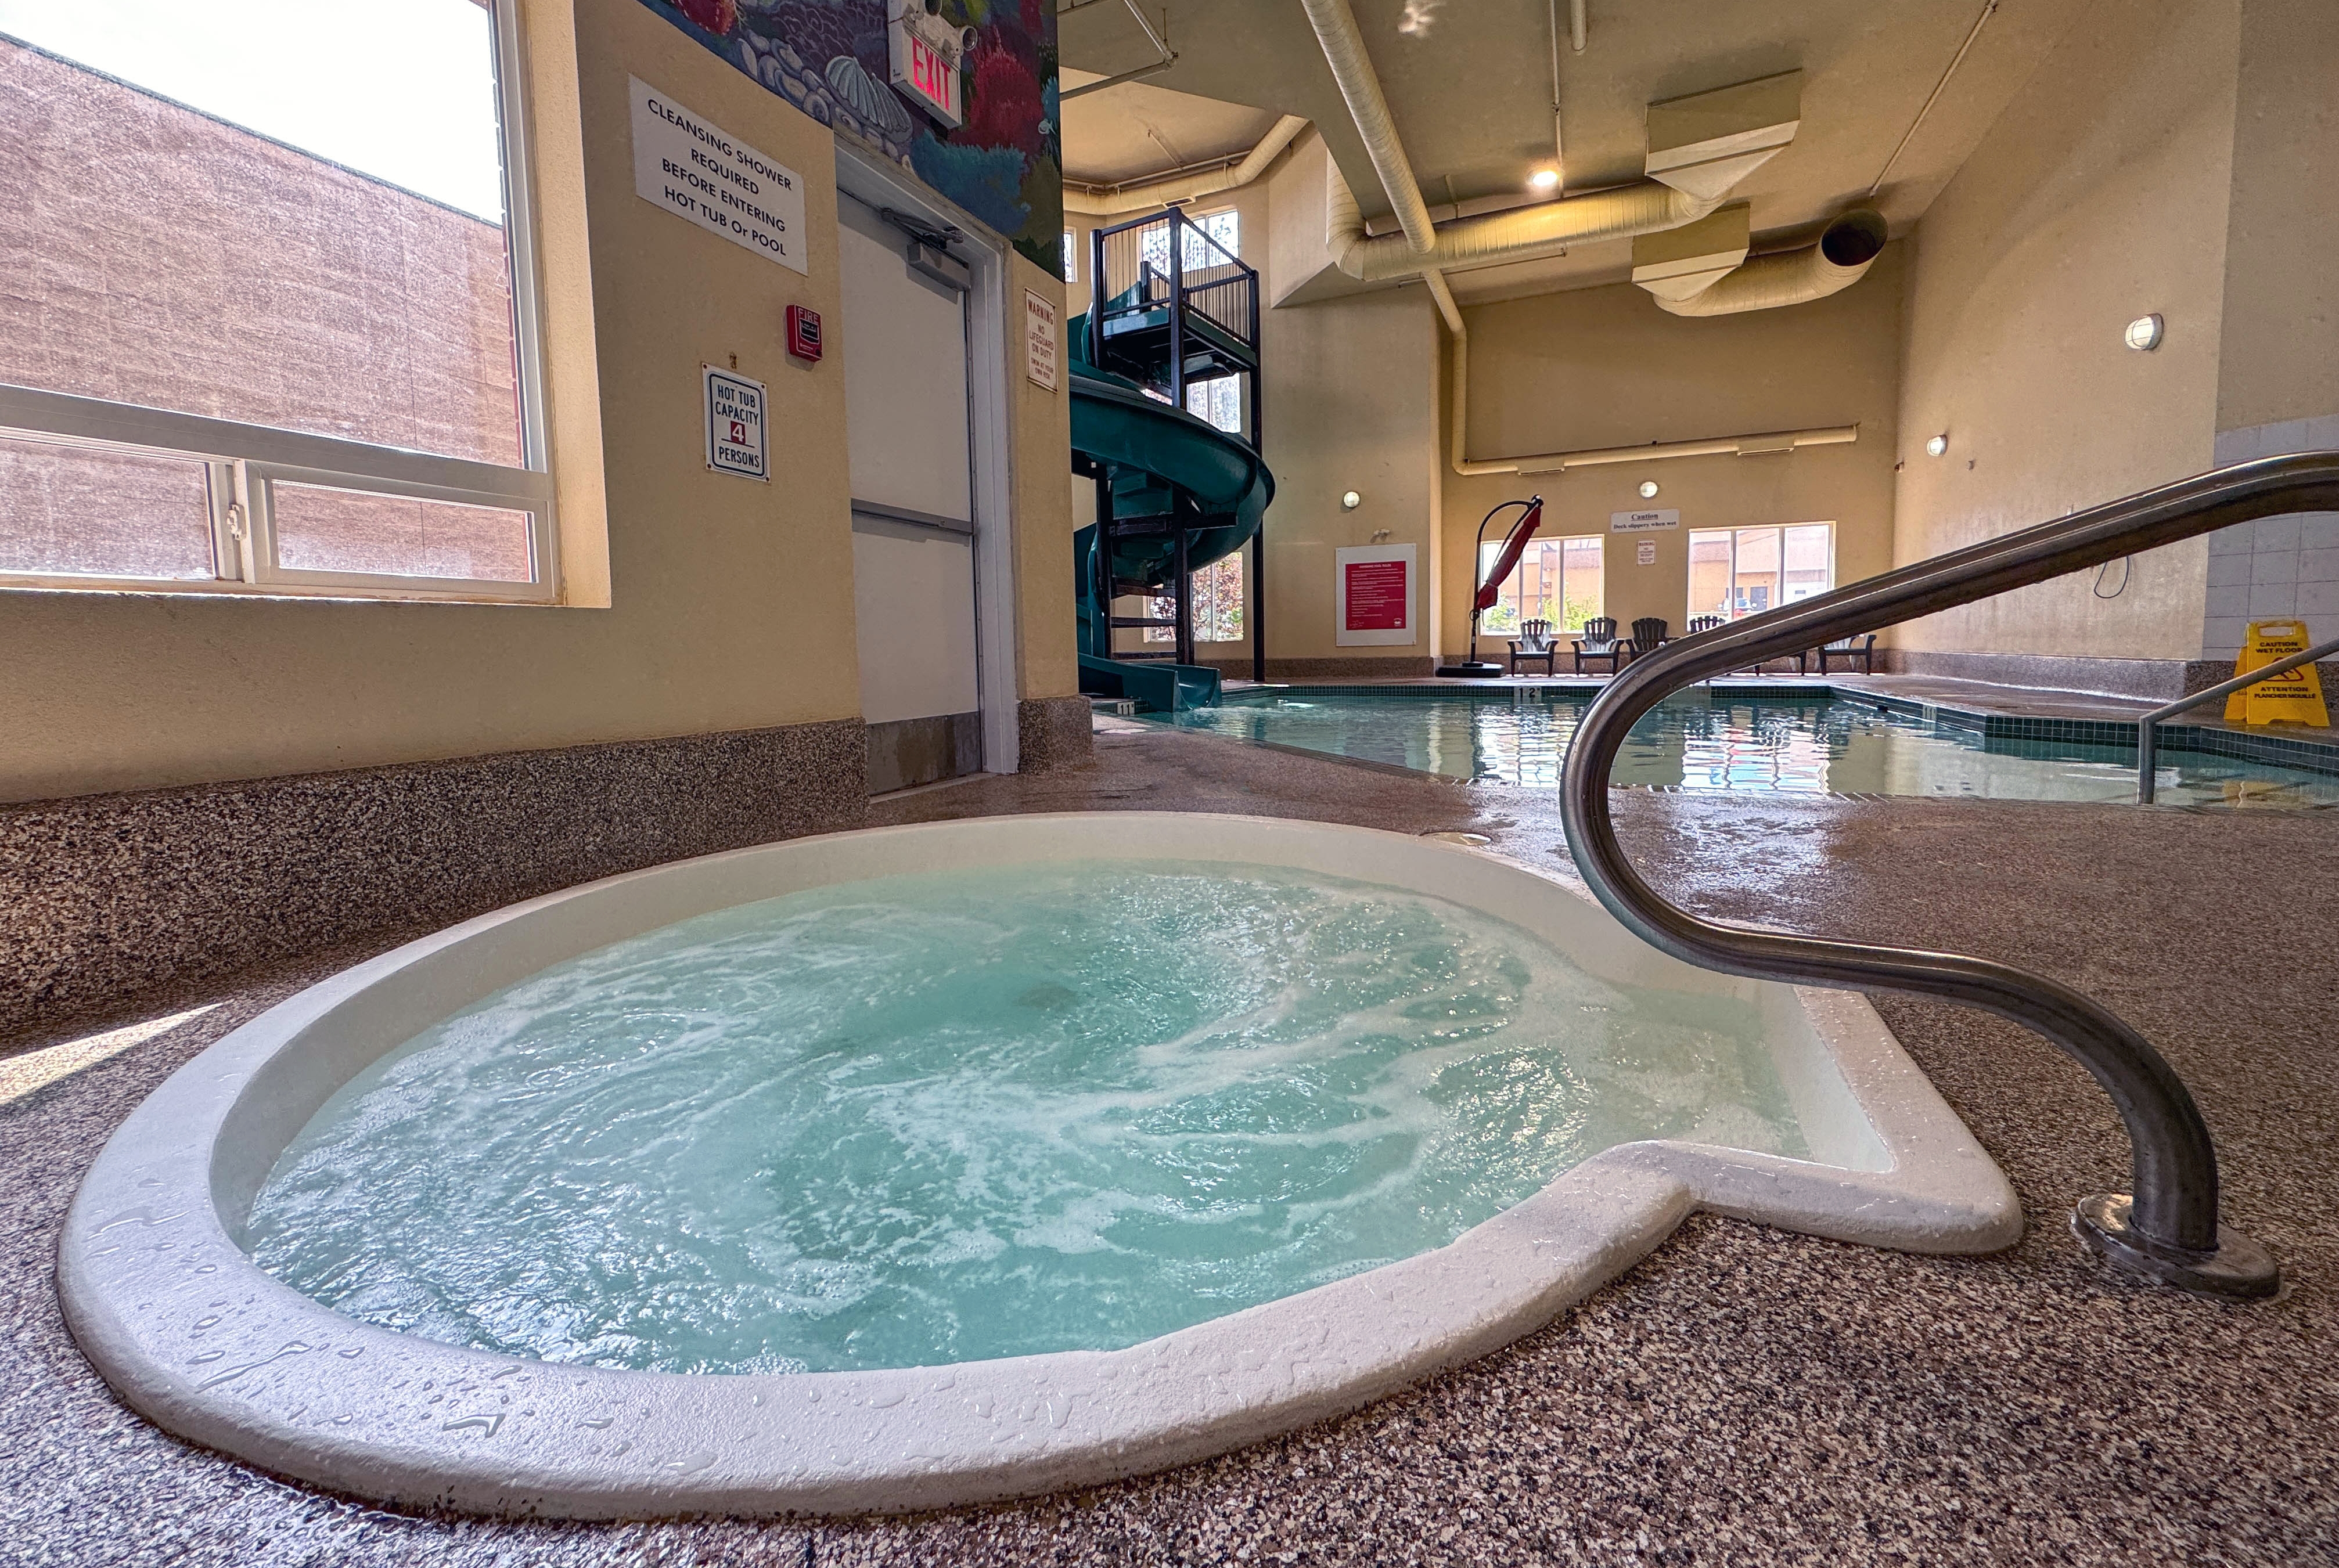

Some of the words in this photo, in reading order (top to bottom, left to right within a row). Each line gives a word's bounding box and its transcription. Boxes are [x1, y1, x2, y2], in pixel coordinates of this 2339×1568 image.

[912, 36, 951, 110] EXIT
[648, 99, 732, 157] CLEANSING
[736, 150, 791, 191] SHOWER
[690, 148, 759, 195] REQUIRED
[663, 158, 716, 198] BEFORE
[721, 191, 786, 232] ENTERING
[665, 185, 696, 211] HOT
[700, 203, 726, 226] TUB
[731, 221, 748, 236] Or
[752, 229, 786, 256] POOL
[798, 307, 819, 324] FIRE
[1028, 298, 1053, 325] WARNING
[1029, 330, 1054, 350] LIFEGUARD
[1038, 324, 1045, 335] NO
[1032, 343, 1039, 354] ON
[1040, 347, 1052, 360] DUTY
[718, 384, 735, 402] HOT
[739, 391, 755, 408] TUB
[715, 402, 758, 426] CAPACITY
[732, 424, 744, 442] 4
[719, 446, 760, 468] PERSONS
